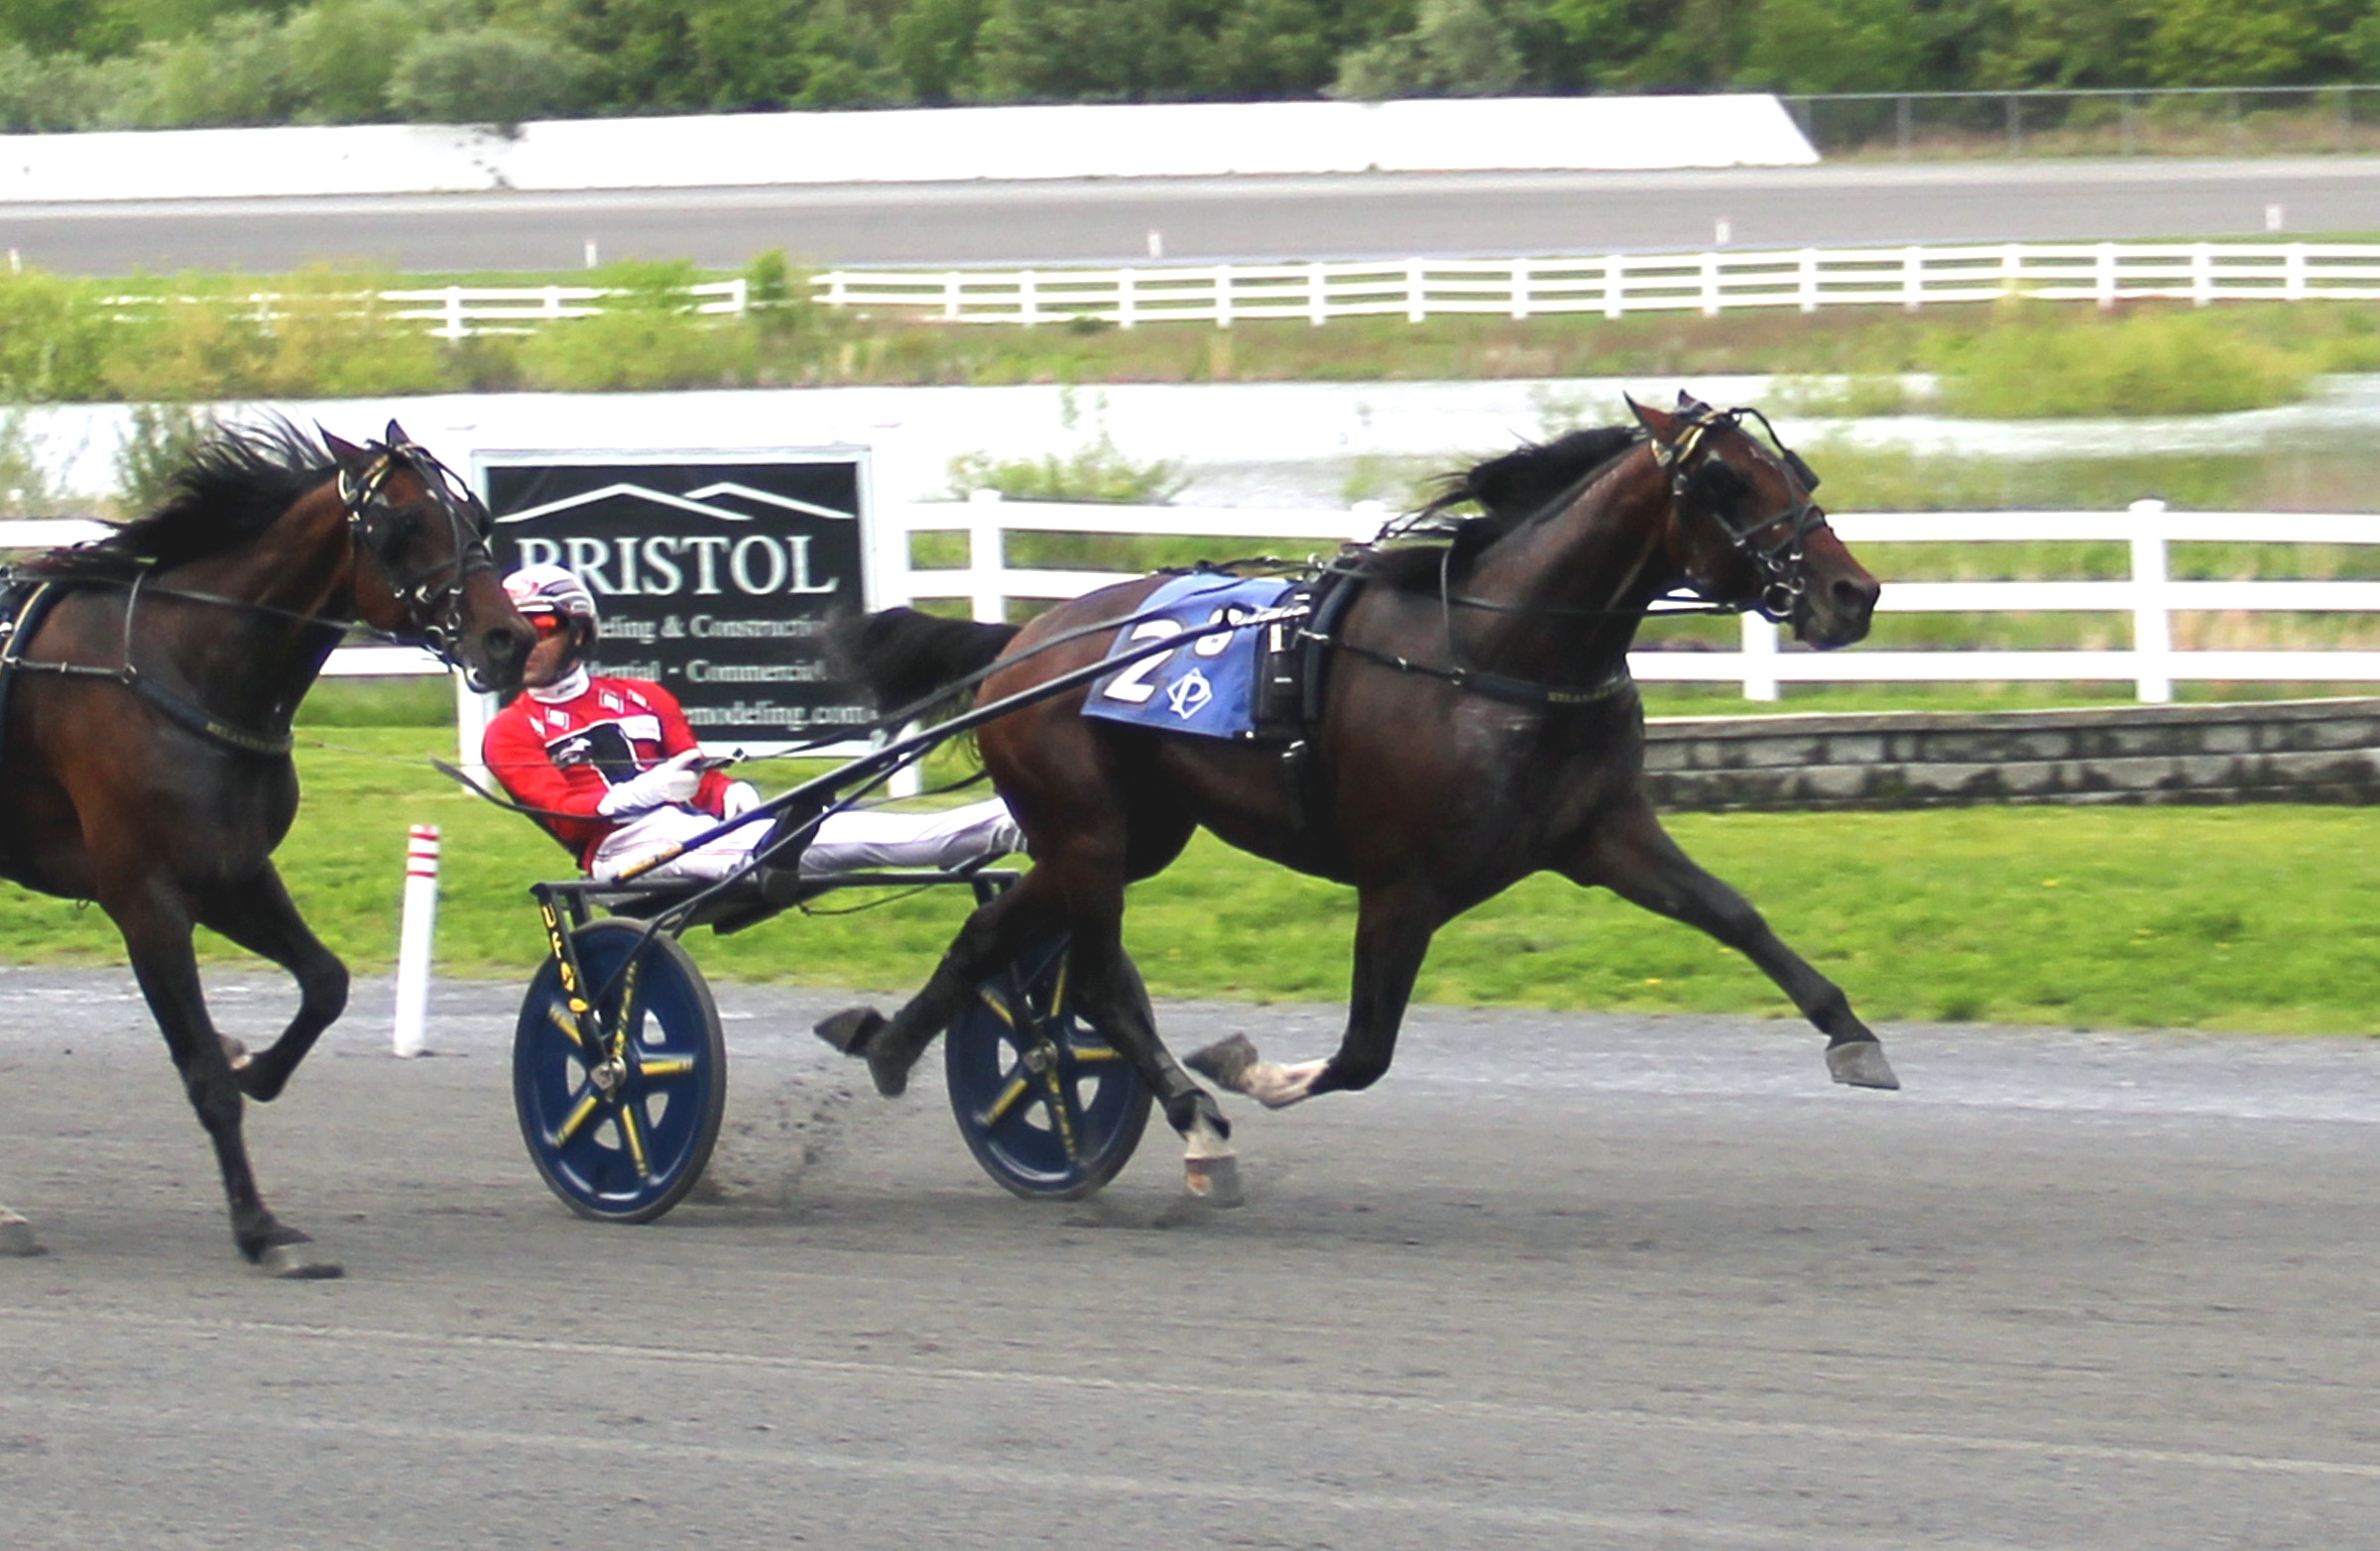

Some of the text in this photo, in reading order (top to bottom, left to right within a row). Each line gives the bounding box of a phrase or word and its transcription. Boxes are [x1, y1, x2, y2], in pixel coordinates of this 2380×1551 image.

[514, 535, 839, 595] BRISTOL
[660, 615, 686, 638] &
[685, 659, 827, 682] Commercial
[1104, 619, 1183, 703] 2
[680, 700, 872, 731] emodeling.com
